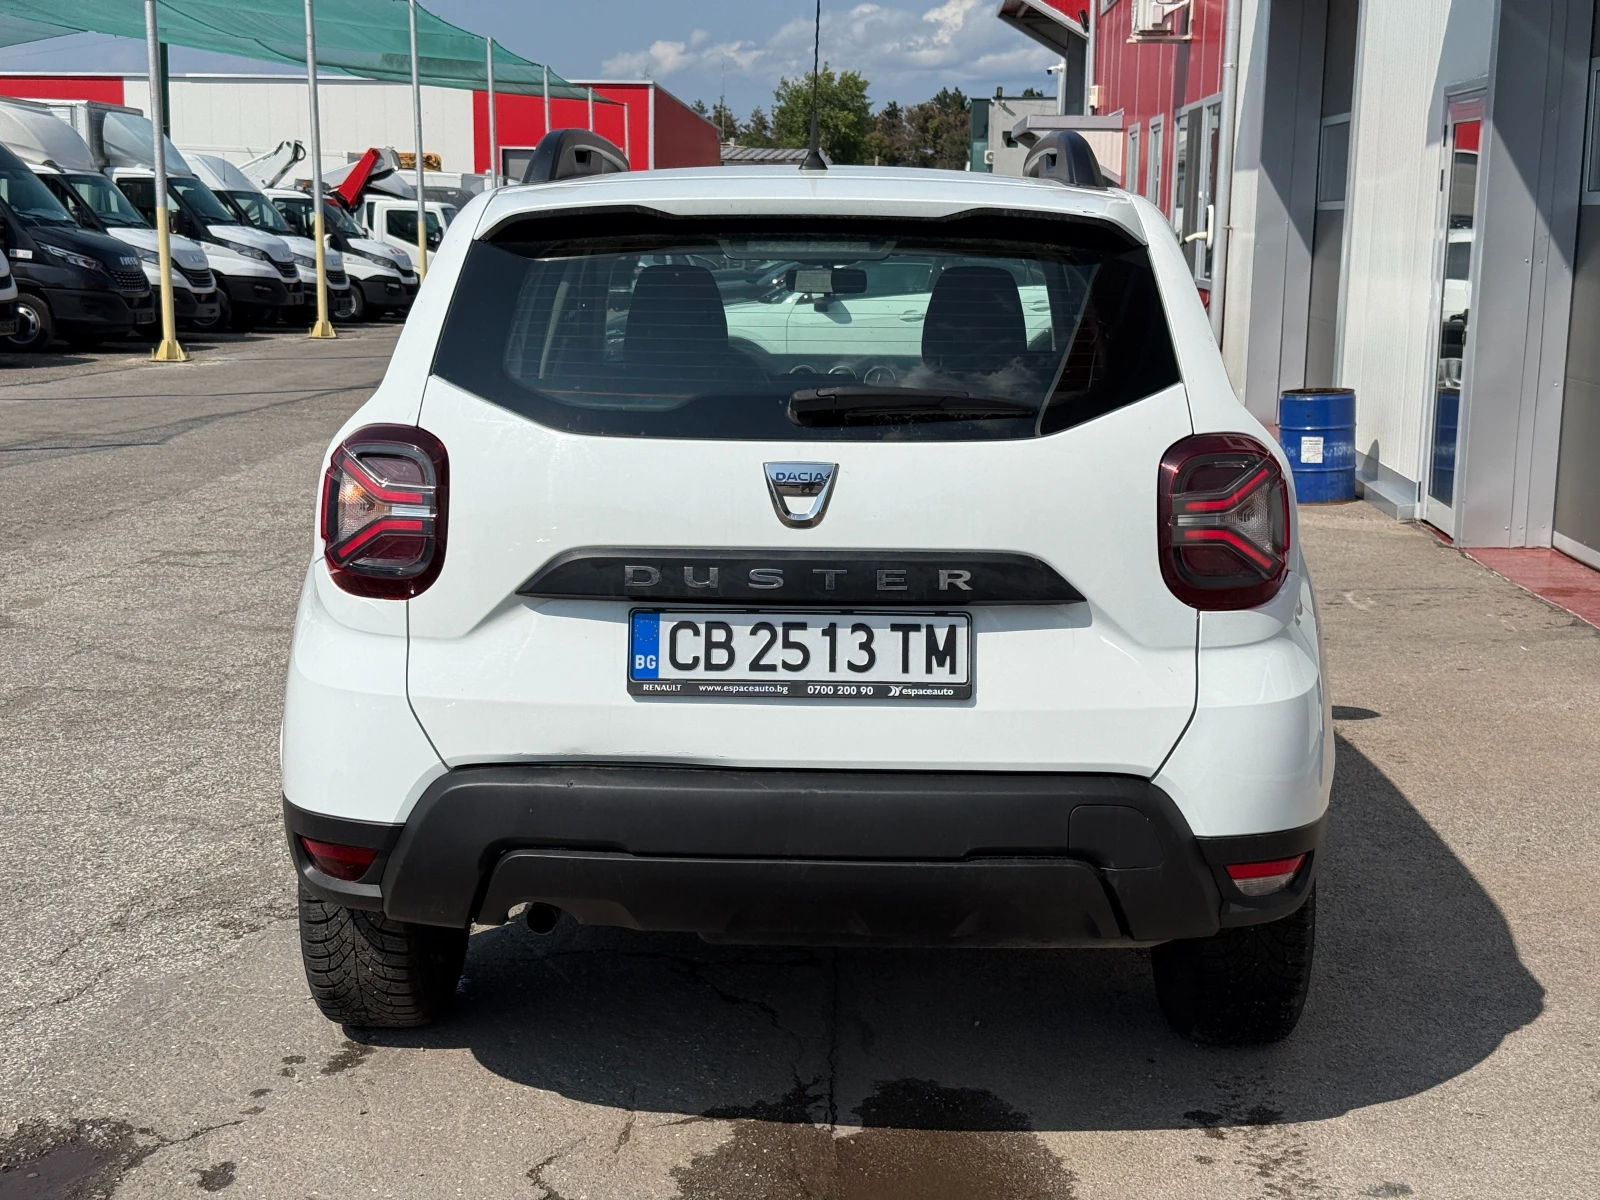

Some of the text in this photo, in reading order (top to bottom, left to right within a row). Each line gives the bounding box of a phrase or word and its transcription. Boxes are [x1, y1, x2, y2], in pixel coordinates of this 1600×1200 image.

[775, 472, 825, 482] DACIA
[624, 565, 973, 591] DUSTER
[669, 620, 957, 674] CB 2513 TM
[635, 654, 657, 669] BG
[698, 685, 789, 694] www.espaceauto.bg
[807, 685, 834, 694] 0700
[837, 686, 857, 694] 200
[860, 686, 874, 695] 90
[901, 688, 954, 696] espaceauto
